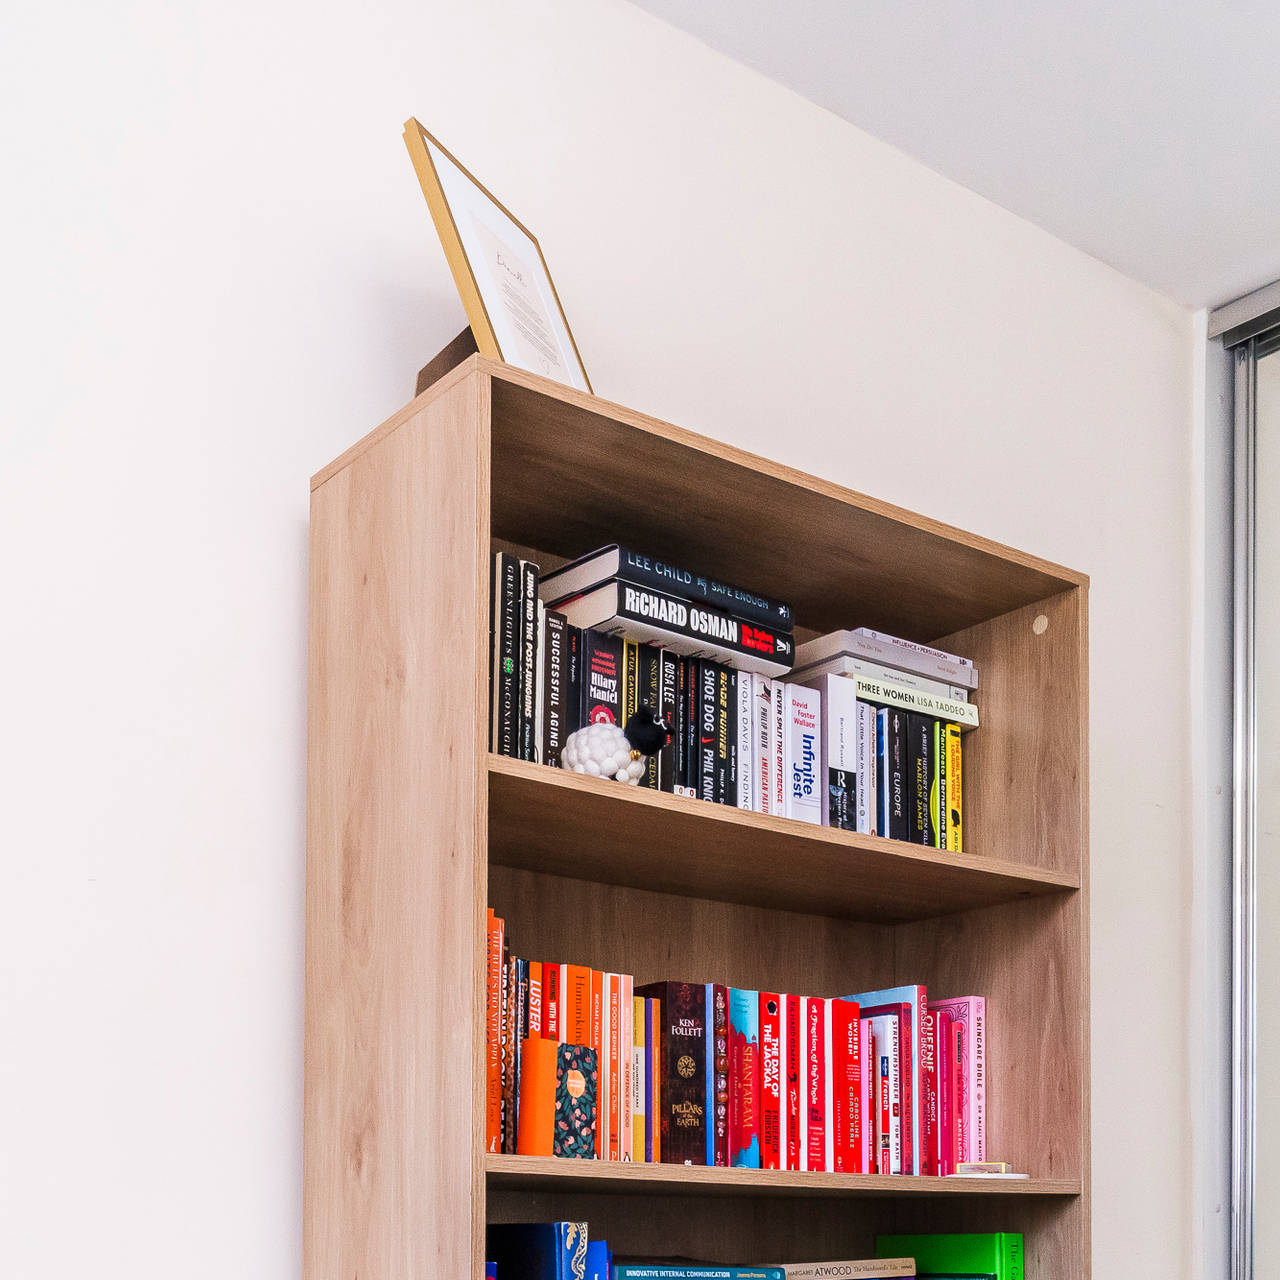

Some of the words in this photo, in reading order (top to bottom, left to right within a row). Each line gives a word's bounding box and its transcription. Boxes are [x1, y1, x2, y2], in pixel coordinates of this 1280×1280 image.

[526, 571, 535, 598] JUNG
[627, 551, 651, 572] LEE
[655, 562, 692, 585] CHILD
[711, 581, 733, 598] SAFE
[735, 590, 769, 610] ENOUGH
[505, 565, 515, 655] GREENLIGHTS
[625, 587, 688, 627] RiCHARD
[690, 608, 738, 643] OSMAN
[526, 622, 535, 641] THE
[550, 631, 561, 706] SUCCESSFUL
[627, 649, 635, 672] ATUL
[591, 672, 617, 692] Hilary
[649, 659, 657, 690] SNOW
[663, 661, 676, 684] ROSA
[589, 686, 618, 704] Mantel
[663, 686, 676, 704] LEE
[703, 669, 715, 702] SHOE
[720, 671, 728, 708] BLADE
[791, 699, 808, 710] David
[857, 680, 881, 696] THREE
[882, 687, 915, 704] WOMEN
[917, 696, 934, 710] LISA
[935, 701, 965, 717] TADDEO
[703, 704, 715, 732] DOG
[761, 707, 769, 728] PHILIP
[793, 717, 816, 729] Wallace
[797, 709, 816, 720] Foster
[550, 712, 561, 747] AGING
[720, 709, 728, 760] RUNNER
[761, 730, 769, 749] ROTH
[703, 748, 715, 775] PHIL
[802, 733, 816, 797] Infinite
[761, 757, 769, 791] AMERICAN
[793, 763, 803, 799] Jest
[893, 771, 902, 817] EUROPE
[922, 791, 929, 801] OF
[529, 980, 541, 1032] LUSTER
[549, 1002, 557, 1018] WITH
[575, 976, 586, 1046] Humankind
[549, 1020, 557, 1033] THE
[671, 1025, 703, 1038] FOLLETT
[679, 1018, 694, 1027] KEN
[763, 1024, 772, 1043] THE
[771, 1037, 779, 1057] THE
[811, 1053, 818, 1063] of
[763, 1044, 772, 1089] JACKAL
[771, 1059, 779, 1080] DAY
[742, 1046, 753, 1127] SHANTARAM
[771, 1082, 779, 1098] OF
[672, 1103, 703, 1116] PILLARS
[676, 1118, 700, 1128] EARTH
[764, 1110, 772, 1145] FORSYTH
[1008, 1242, 1019, 1264] The
[625, 1269, 659, 1278] INNOVATIVE
[659, 1270, 686, 1278] INTERNAL
[686, 1270, 731, 1279] COMMUNICATION
[814, 1266, 852, 1277] ATWOOD
